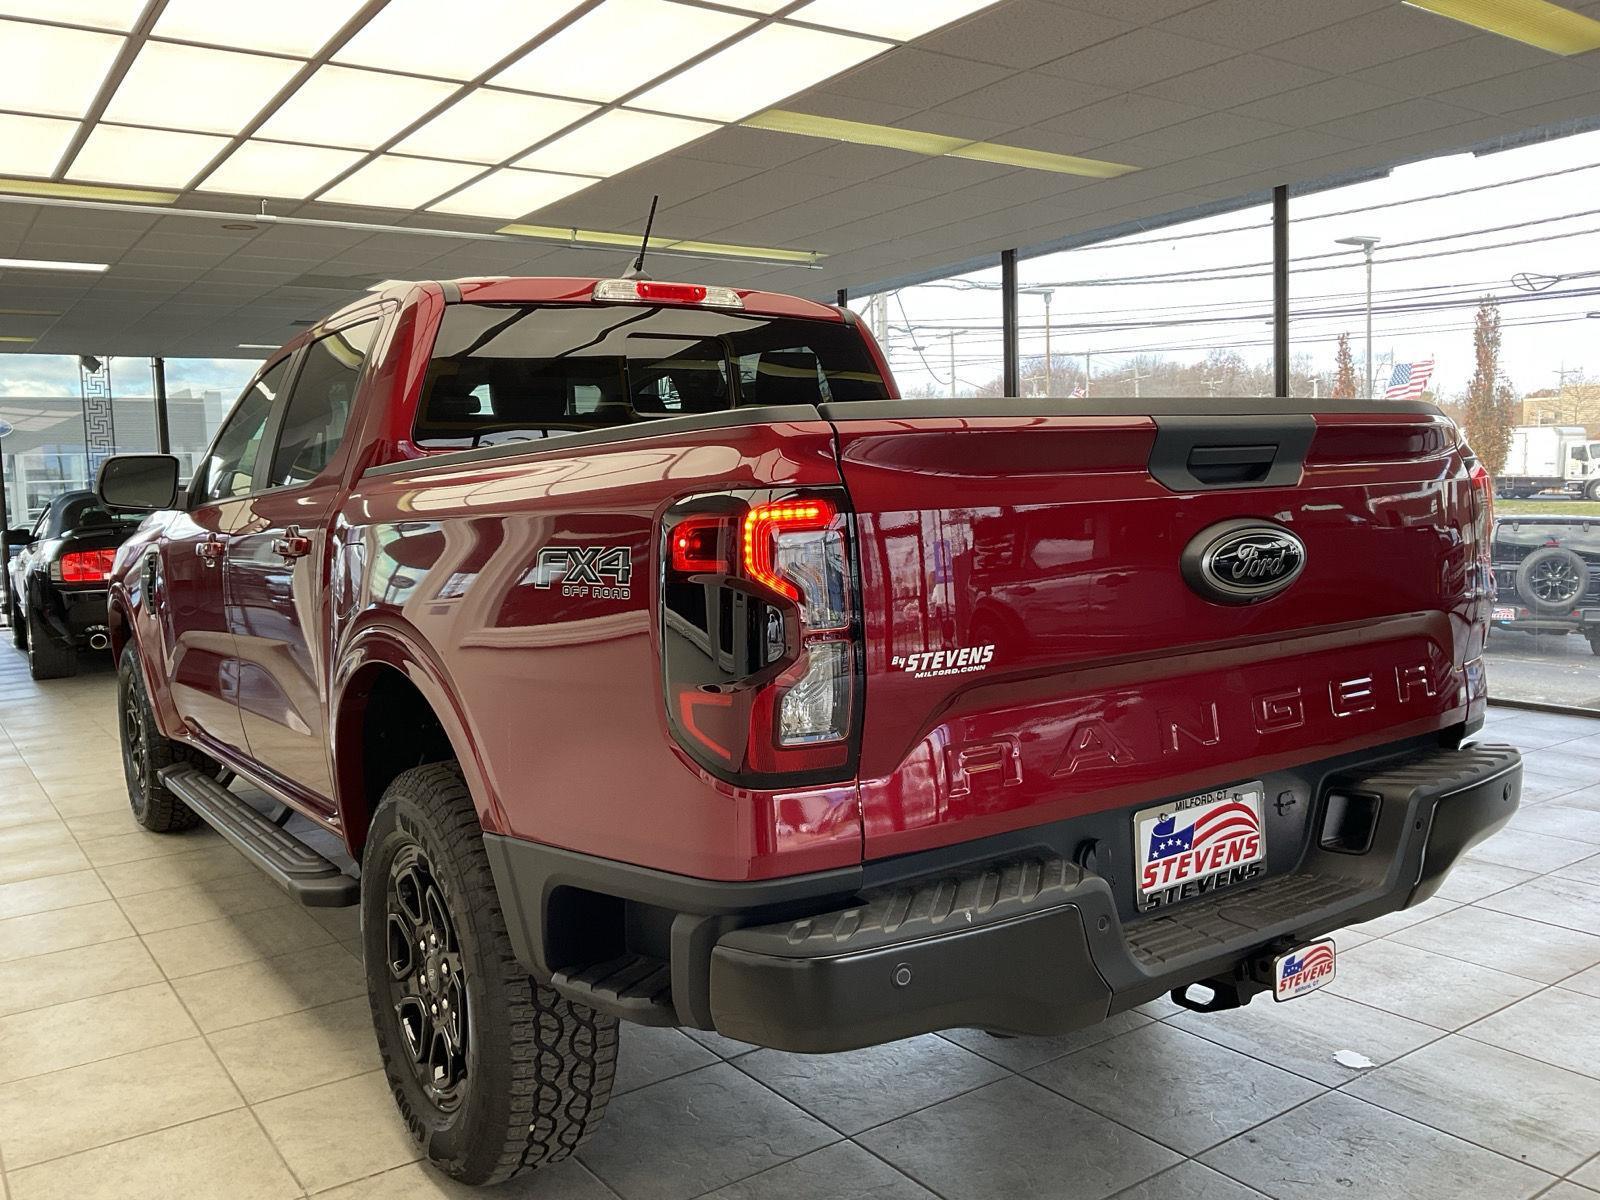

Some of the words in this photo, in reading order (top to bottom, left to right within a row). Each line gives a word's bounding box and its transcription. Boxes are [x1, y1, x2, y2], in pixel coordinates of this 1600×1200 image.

[535, 546, 632, 589] FX4
[1231, 541, 1286, 579] Ford
[562, 586, 589, 597] OFF
[592, 586, 631, 600] ROAD
[905, 644, 995, 673] STEVENS
[946, 656, 1438, 798] RANGER
[1174, 793, 1215, 812] MILFORD,
[1216, 790, 1228, 801] CT
[1141, 833, 1260, 890] STEVENS
[1145, 861, 1262, 911] STEVENS
[1278, 960, 1334, 993] STEVENS
